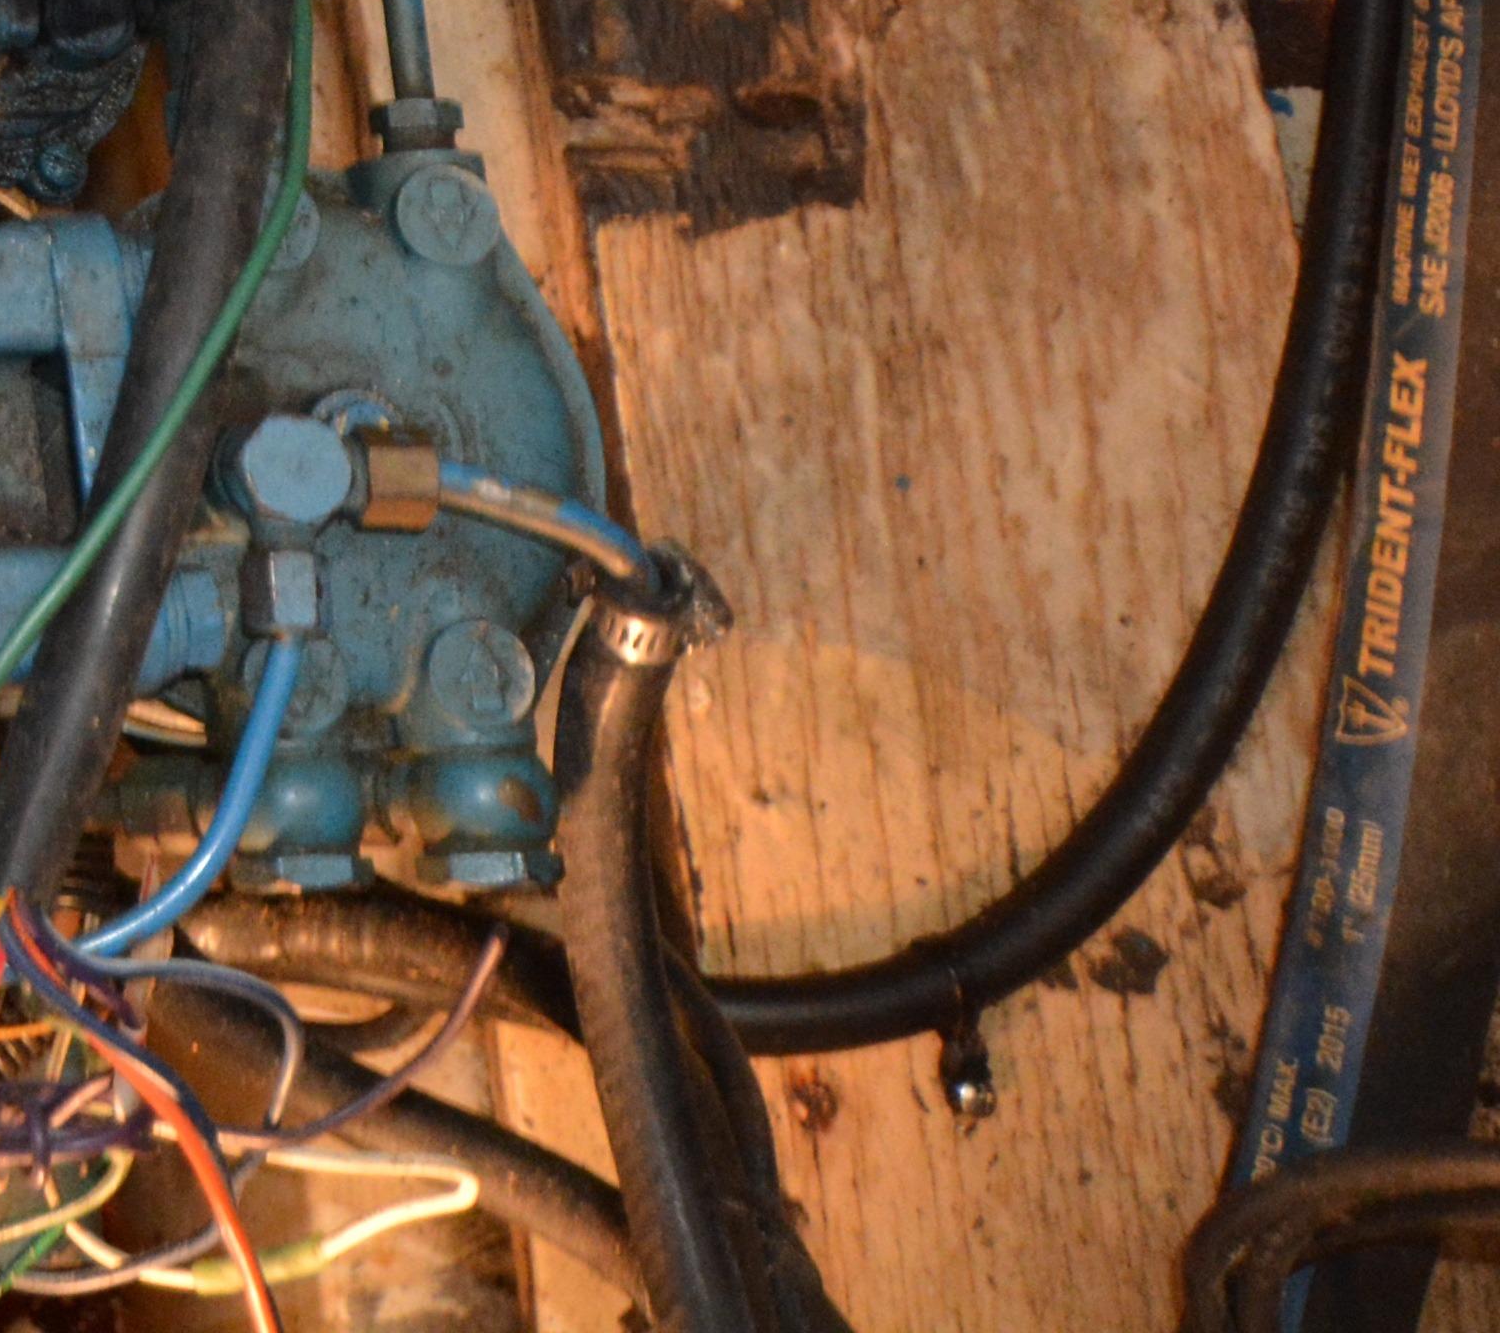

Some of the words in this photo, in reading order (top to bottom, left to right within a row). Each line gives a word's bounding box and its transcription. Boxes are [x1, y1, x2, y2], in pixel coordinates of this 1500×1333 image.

[1405, 19, 1429, 136] EXHAUST
[1401, 142, 1421, 196] WET
[1393, 205, 1415, 304] MARINE
[1419, 259, 1449, 317] SAE
[1359, 355, 1427, 675] TRIDENT-FLEX
[1316, 1005, 1353, 1072] 2015
[1299, 1087, 1337, 1144] (E2)
